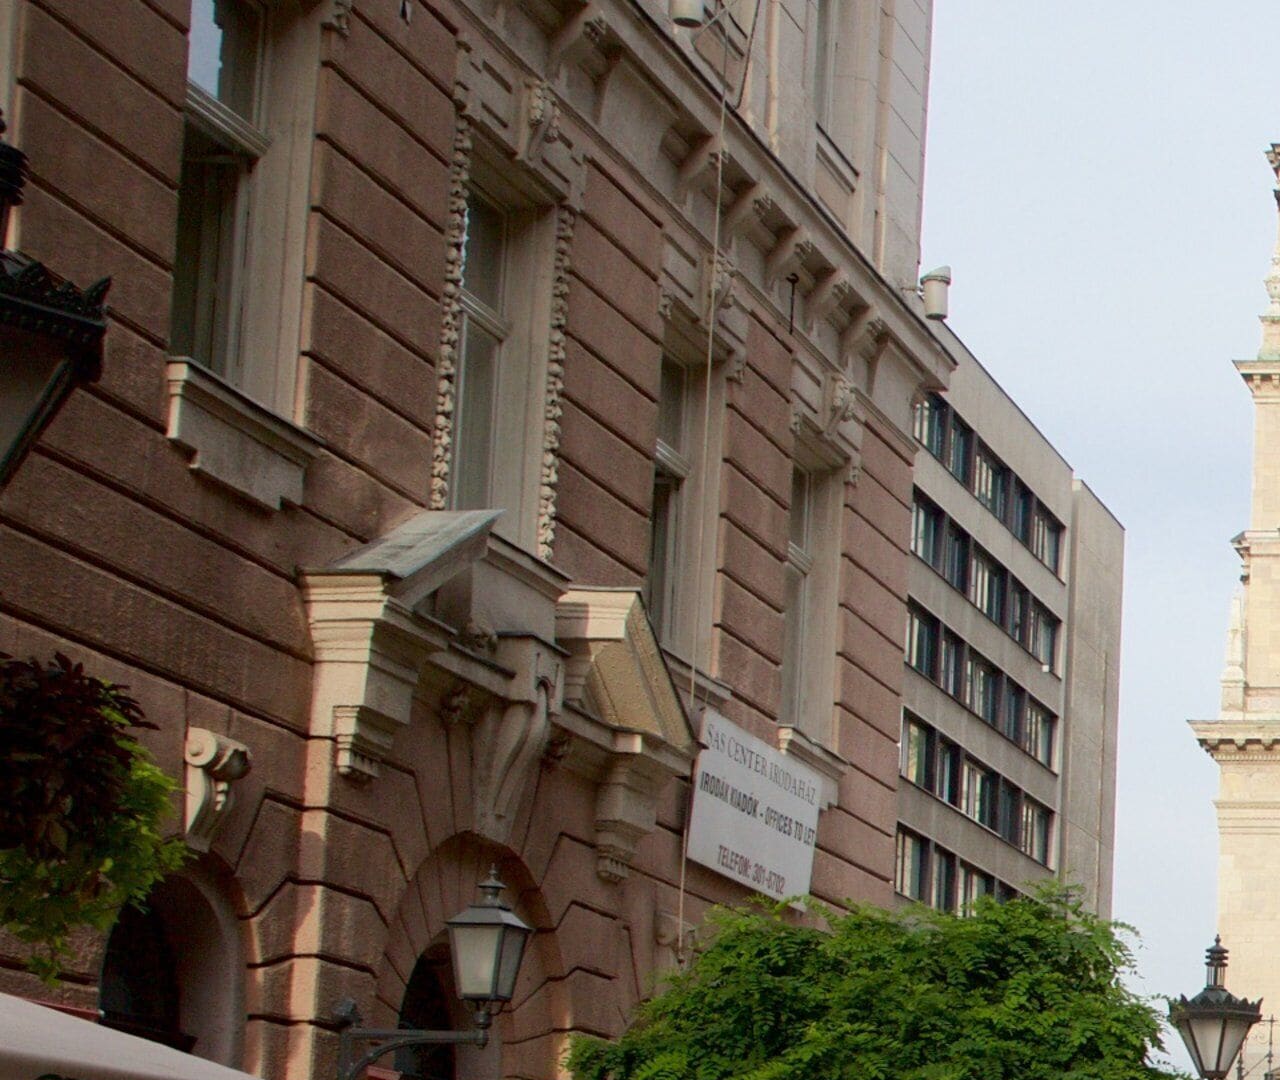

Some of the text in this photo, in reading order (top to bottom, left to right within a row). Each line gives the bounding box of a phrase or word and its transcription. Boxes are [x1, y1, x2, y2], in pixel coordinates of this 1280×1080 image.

[706, 723, 816, 806] SAS CENTER IRODAHÁZ
[699, 771, 729, 803] IRODÁK
[730, 786, 760, 820] KIADÓK
[765, 806, 793, 837] OFFICES
[794, 818, 804, 842] TO
[804, 825, 816, 848] LET
[718, 844, 751, 878] TELEFON:
